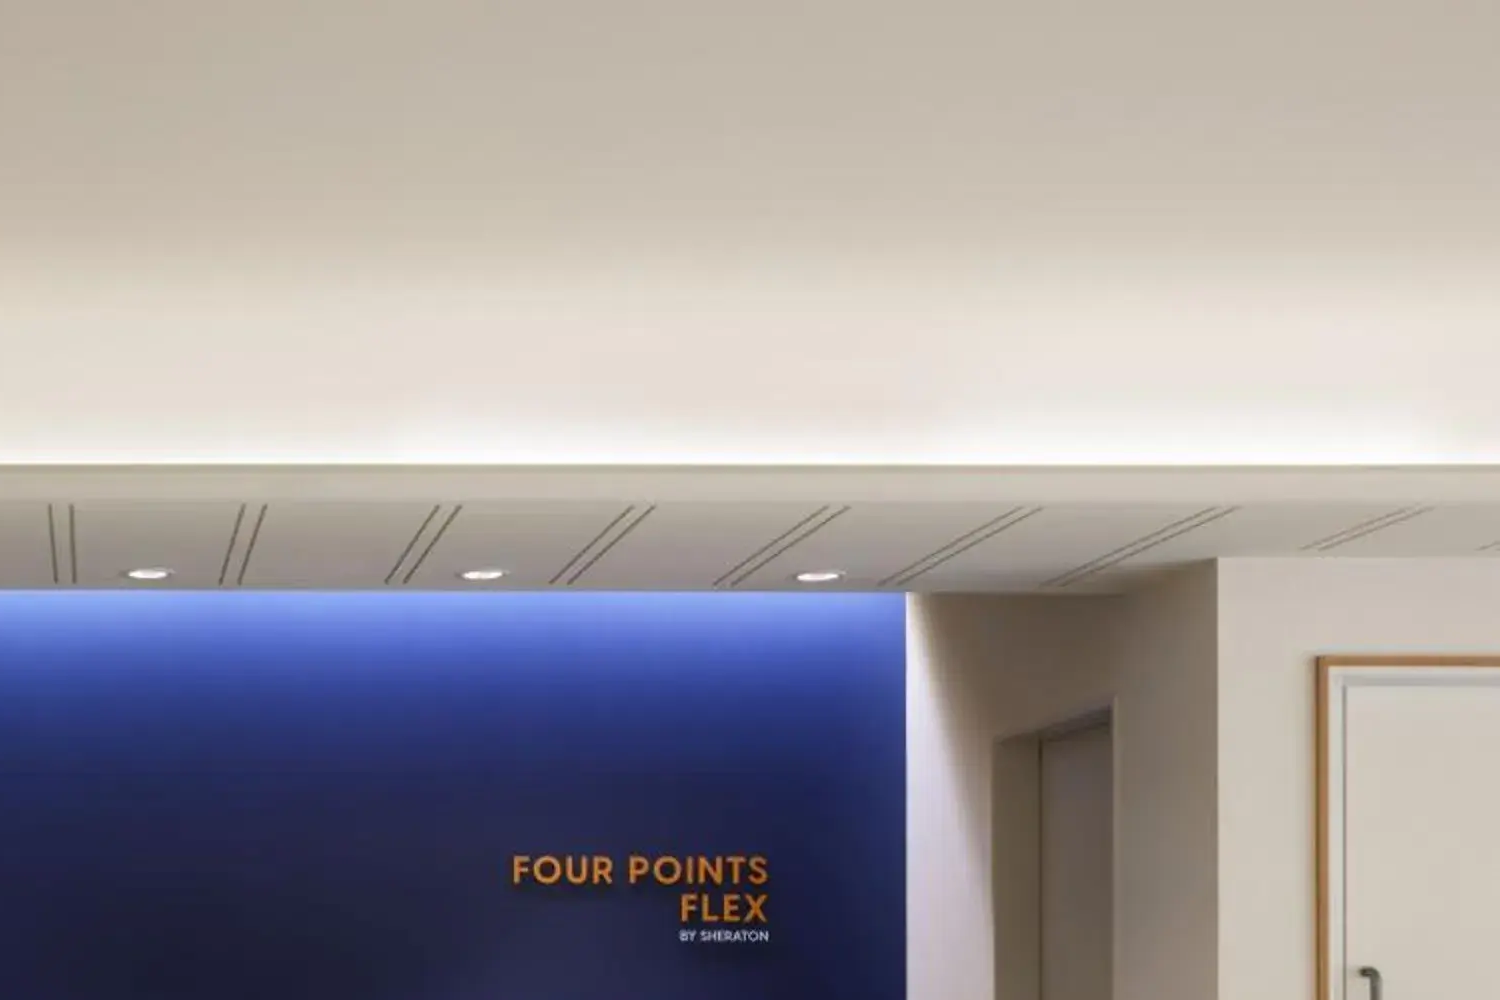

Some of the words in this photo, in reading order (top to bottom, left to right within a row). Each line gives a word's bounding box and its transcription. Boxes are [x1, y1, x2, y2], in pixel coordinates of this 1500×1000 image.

[512, 855, 613, 884] FOUR
[628, 855, 768, 884] POINTS
[680, 894, 768, 922] FLEX
[679, 930, 696, 942] BY
[700, 930, 769, 942] SHERATON
